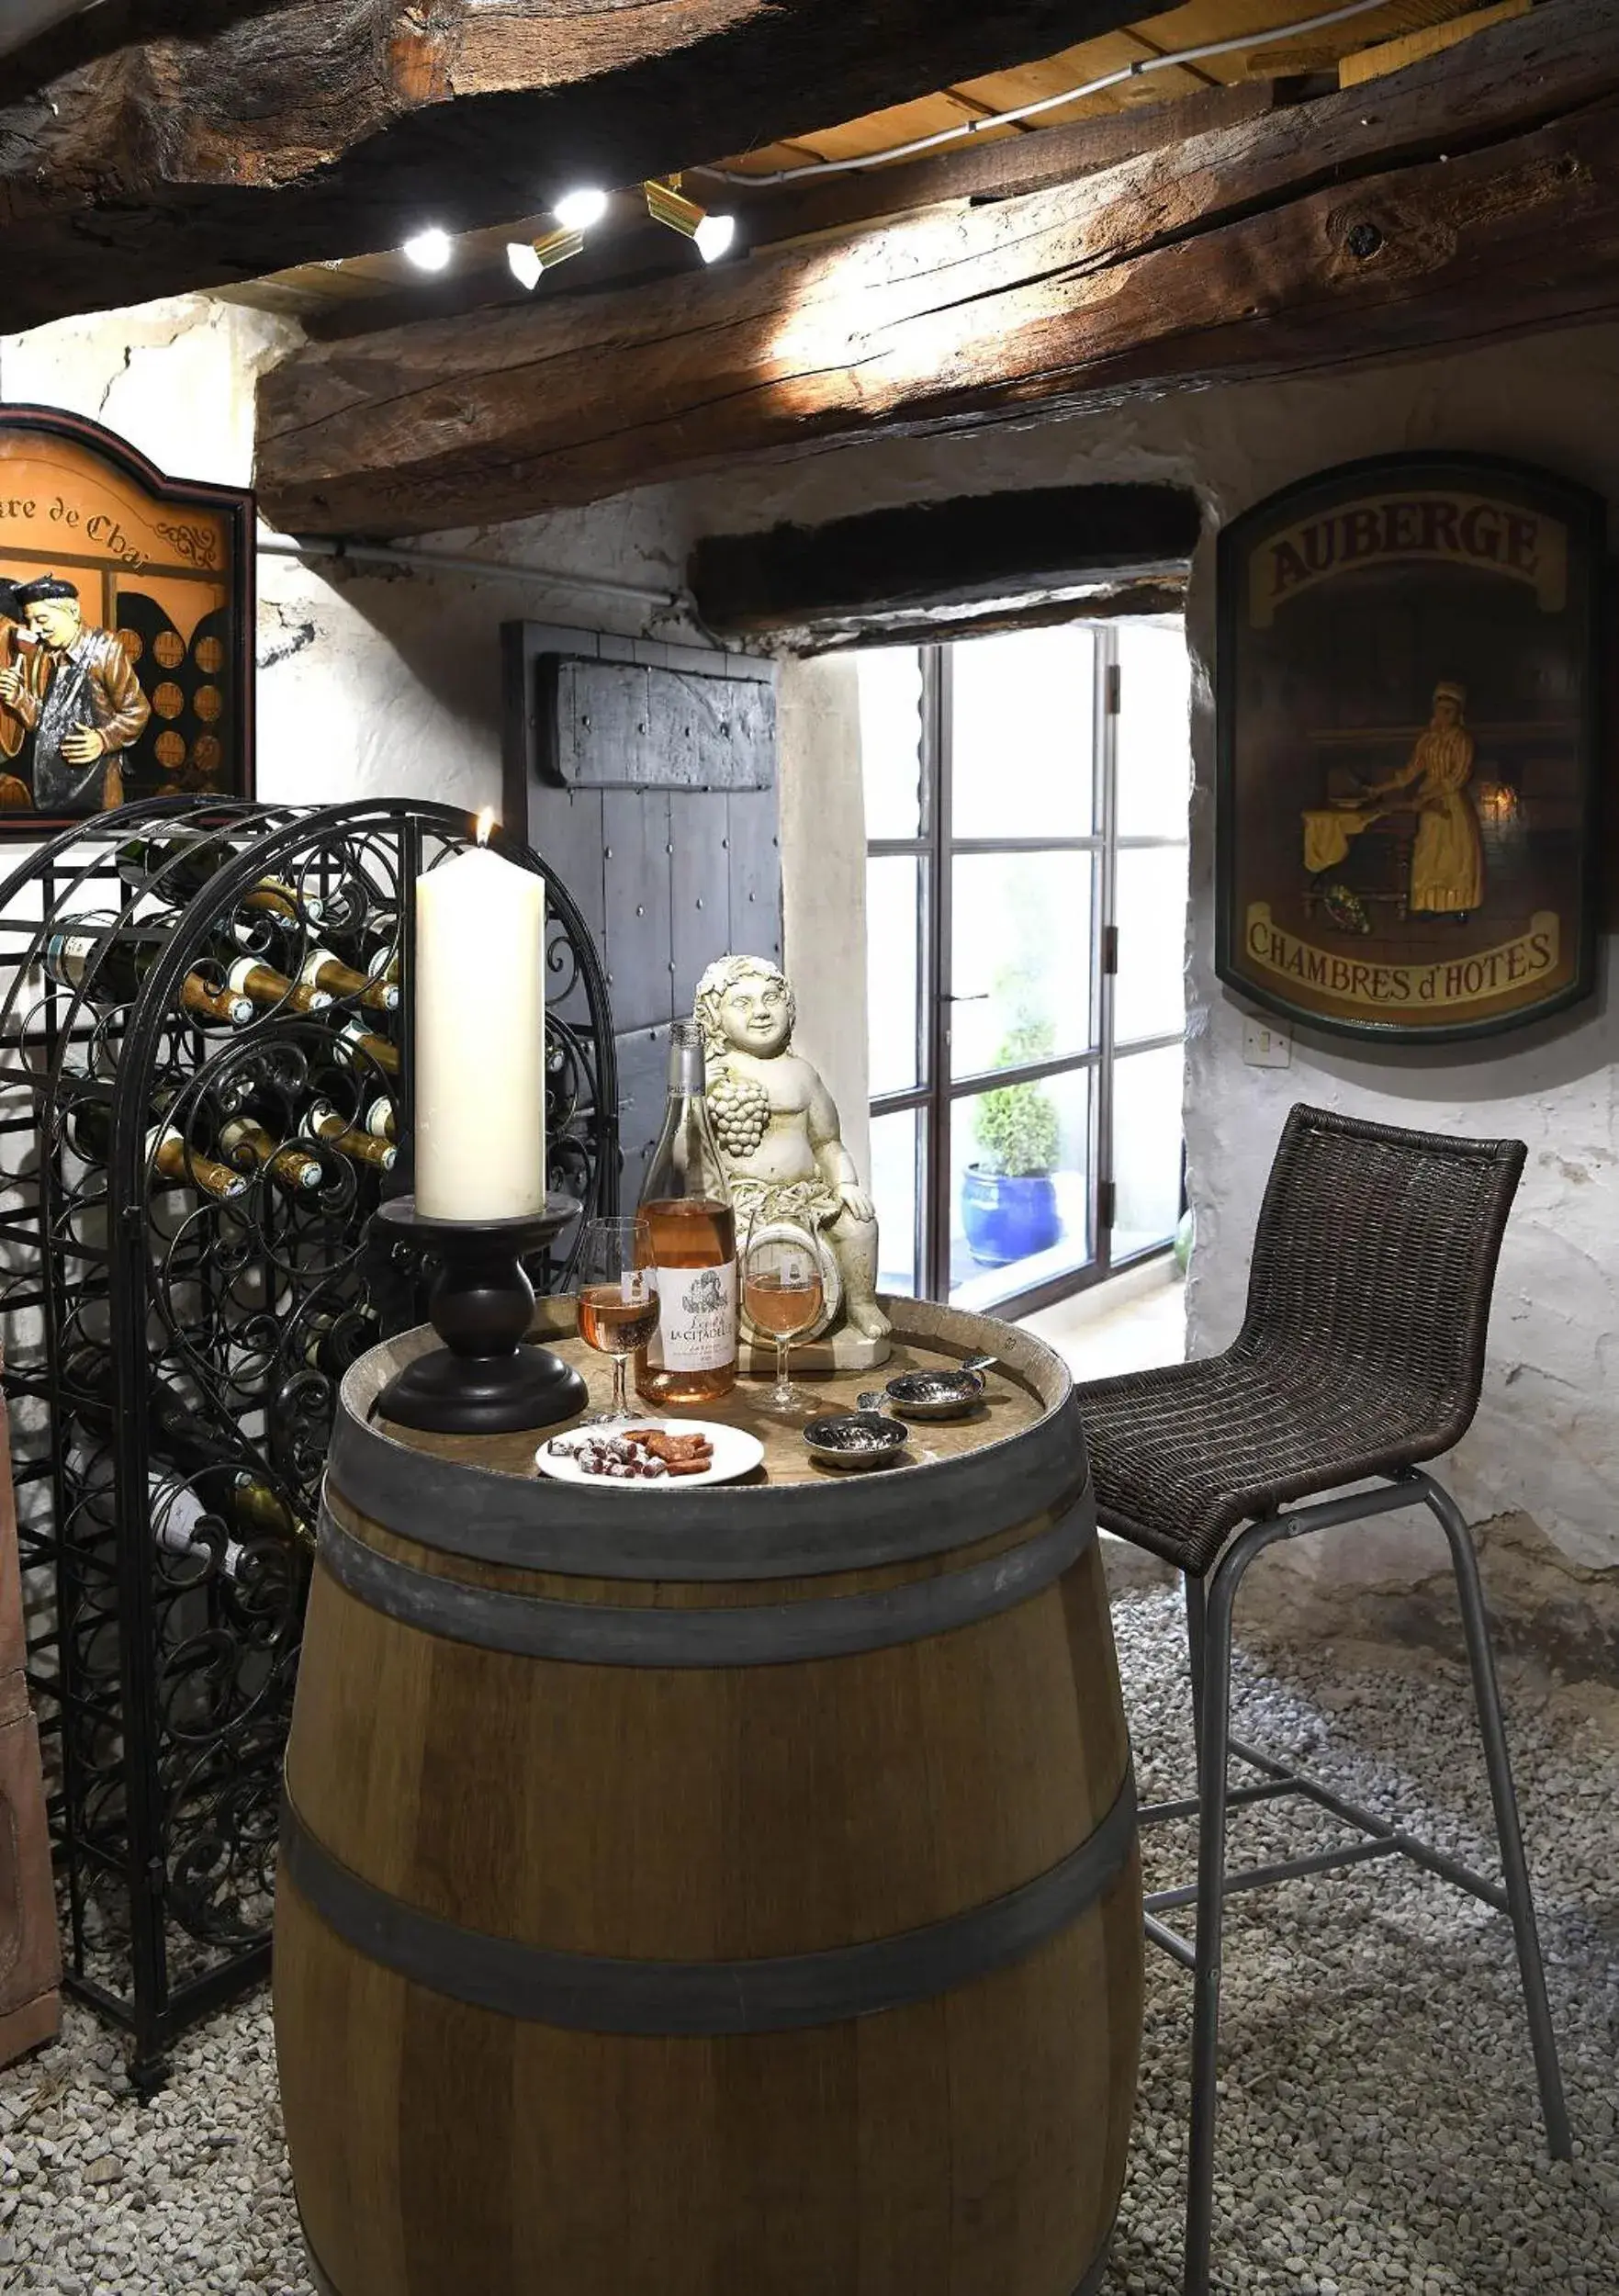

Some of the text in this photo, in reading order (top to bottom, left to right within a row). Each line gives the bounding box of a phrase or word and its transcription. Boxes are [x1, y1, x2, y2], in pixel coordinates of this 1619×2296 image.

[49, 497, 79, 528] de
[86, 515, 150, 577] Chai
[1268, 501, 1540, 597] AUBERGE
[1249, 922, 1411, 1002] CHAMBRES
